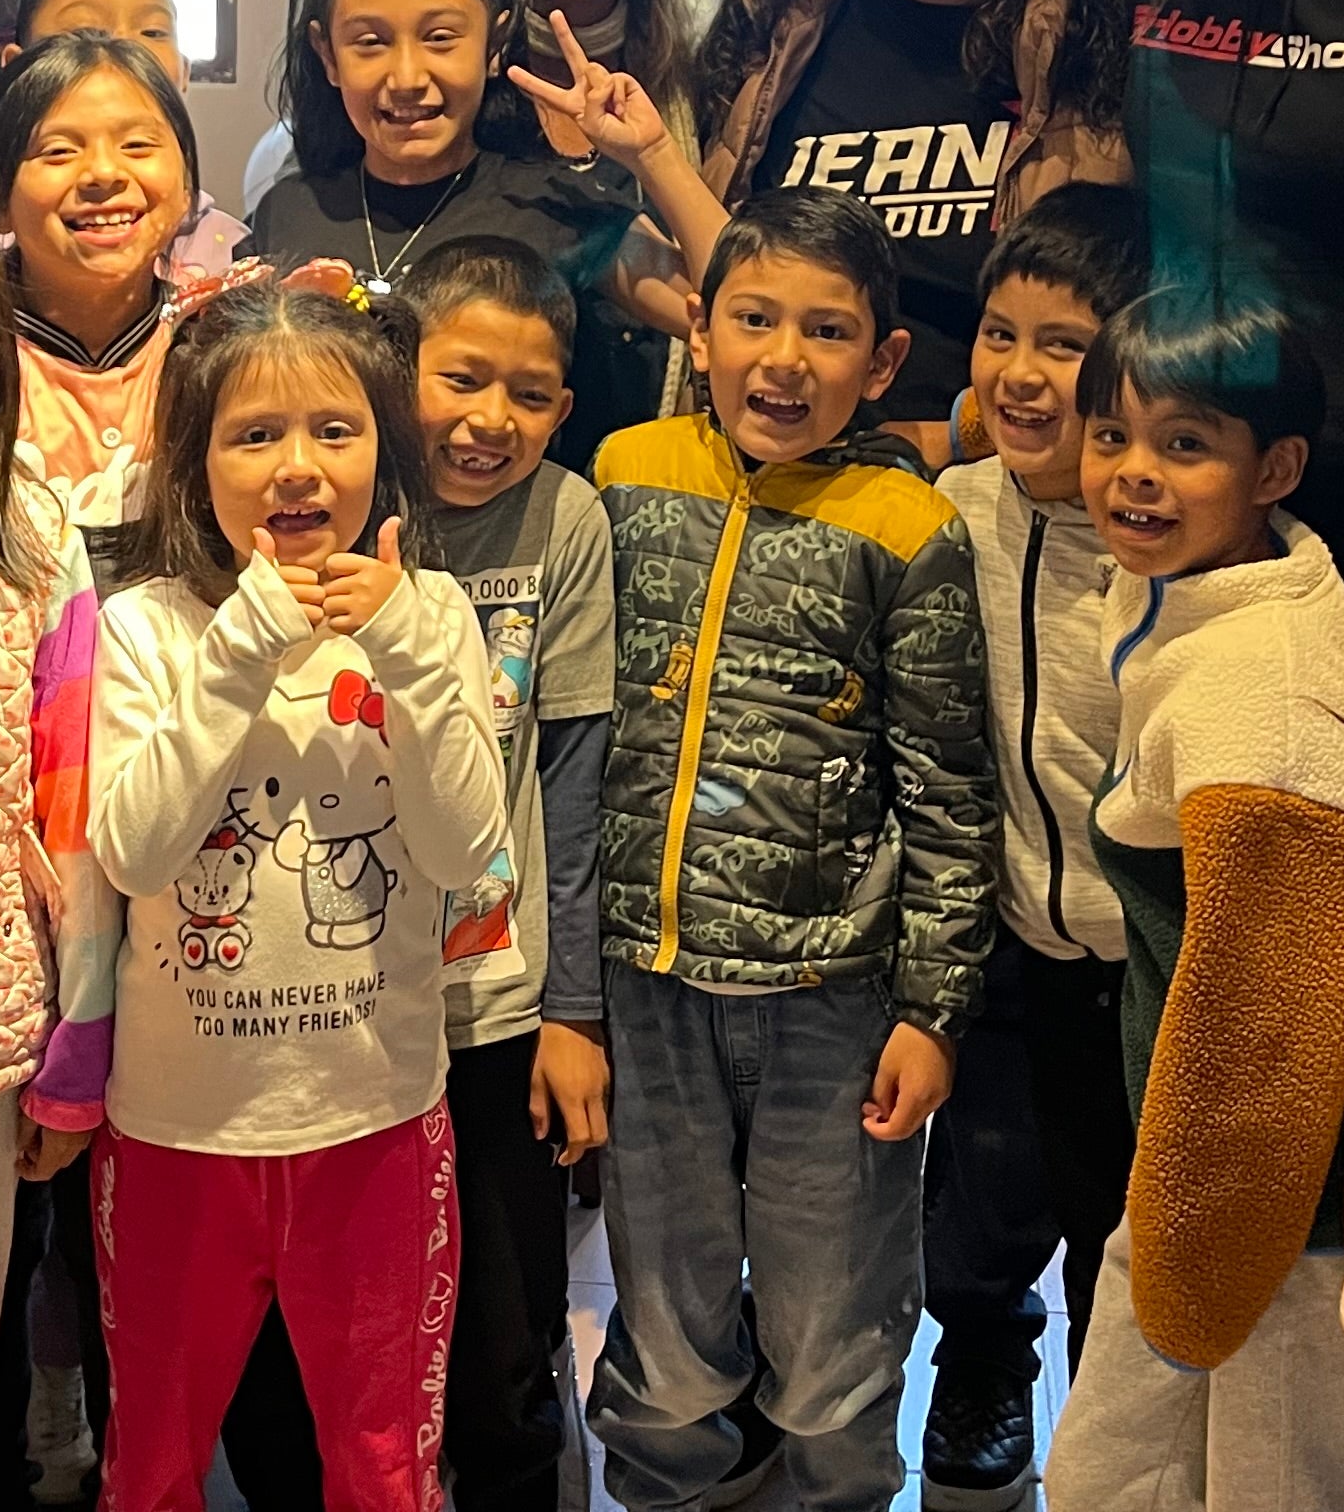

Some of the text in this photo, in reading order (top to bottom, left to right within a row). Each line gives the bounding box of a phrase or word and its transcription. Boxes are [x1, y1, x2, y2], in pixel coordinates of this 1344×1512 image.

[186, 971, 386, 1009] YOU CAN NEVER HAVE
[193, 998, 377, 1037] TOO MANY FRIENDS!
